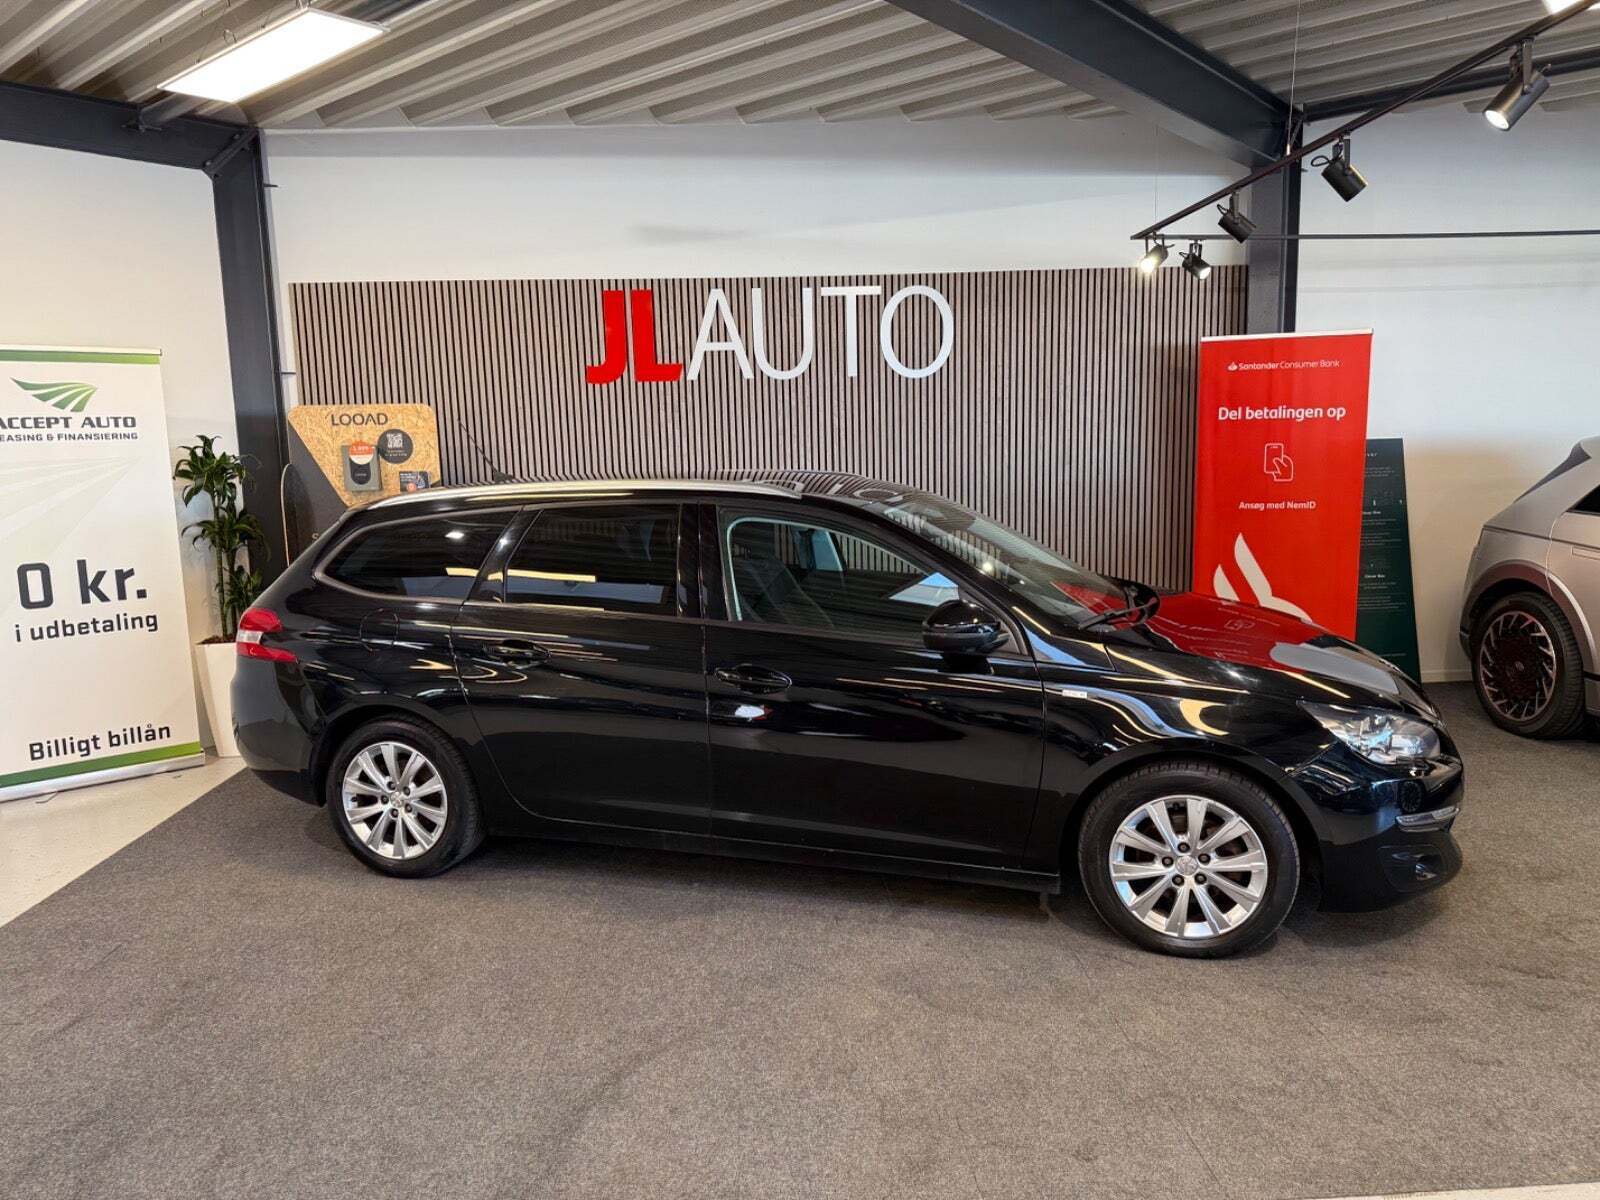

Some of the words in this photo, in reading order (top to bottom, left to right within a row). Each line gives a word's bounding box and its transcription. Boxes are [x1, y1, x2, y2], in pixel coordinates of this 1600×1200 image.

[1238, 361, 1279, 371] Santander
[1280, 360, 1319, 370] Consumer
[1320, 358, 1340, 368] Bank
[331, 413, 389, 426] LOOAD
[1218, 406, 1242, 421] Del
[1245, 405, 1324, 422] betalingen
[1327, 406, 1347, 421] op
[81, 416, 137, 429] AUTO
[46, 432, 54, 441] &
[57, 432, 138, 441] FINANSIERING
[1239, 501, 1265, 512] Ansøg
[1266, 501, 1285, 510] med
[1286, 501, 1316, 510] NemID
[17, 562, 54, 609] 0
[77, 559, 147, 605] kr.
[15, 624, 21, 642] i
[30, 613, 158, 641] udbetaling
[29, 737, 101, 761] Billigt
[108, 724, 171, 748] billån
